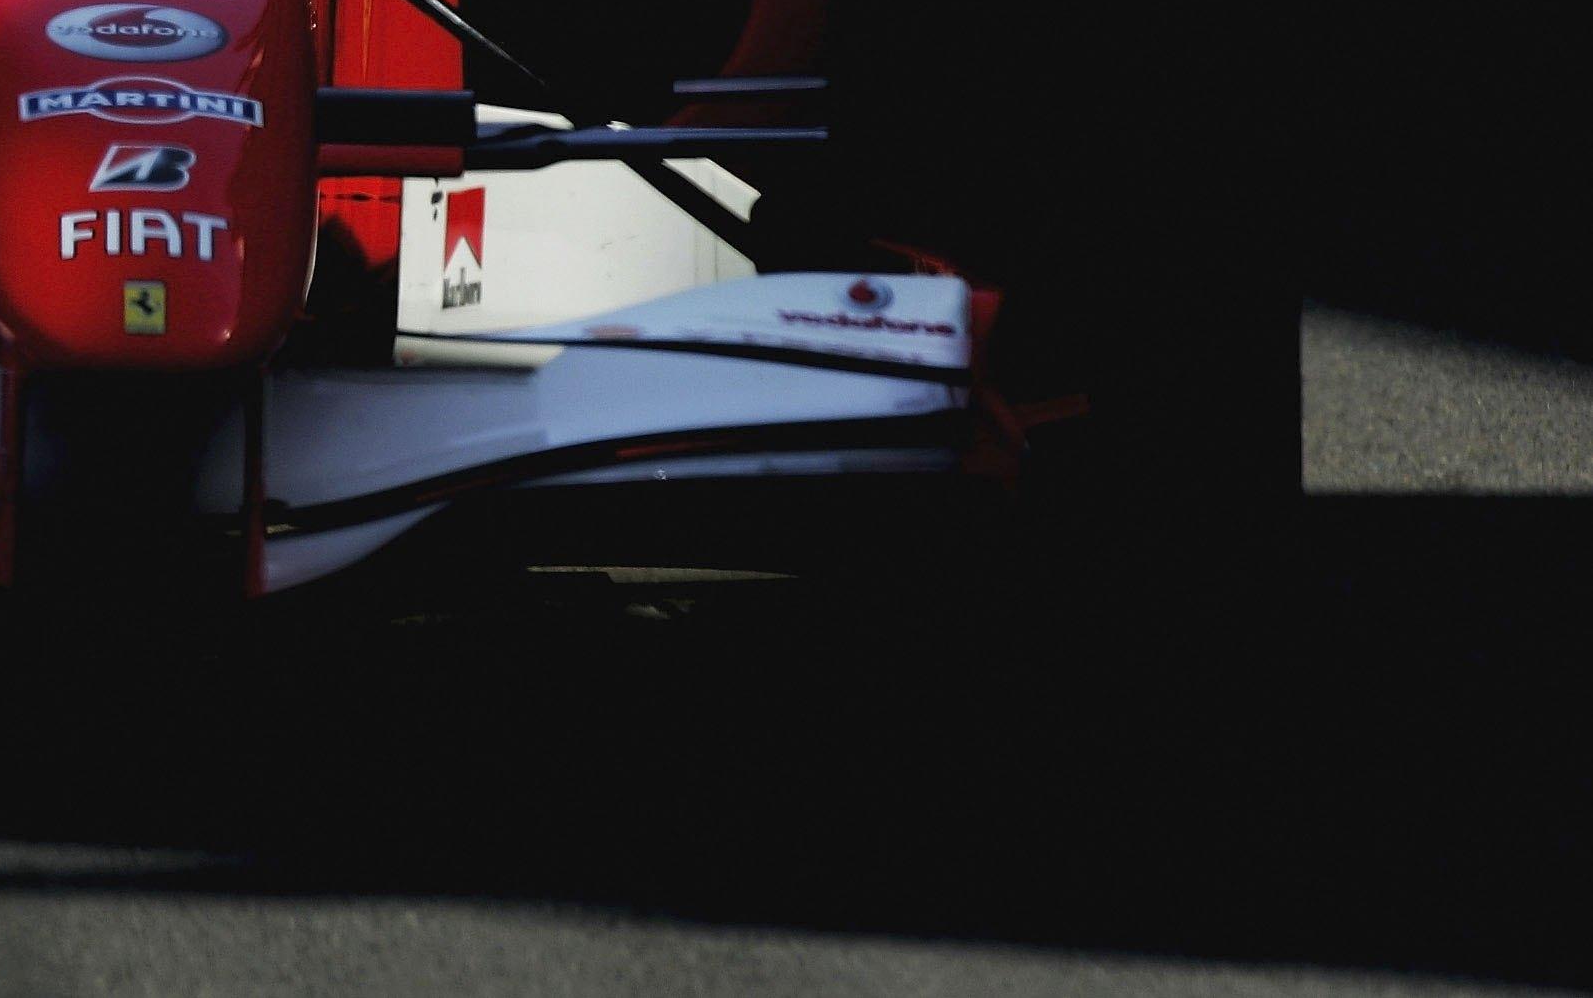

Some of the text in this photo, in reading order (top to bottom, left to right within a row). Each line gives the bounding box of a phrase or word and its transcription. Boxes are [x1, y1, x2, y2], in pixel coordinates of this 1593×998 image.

[55, 12, 221, 39] vodafone
[37, 92, 247, 116] MARTINI
[59, 209, 228, 261] FIAT
